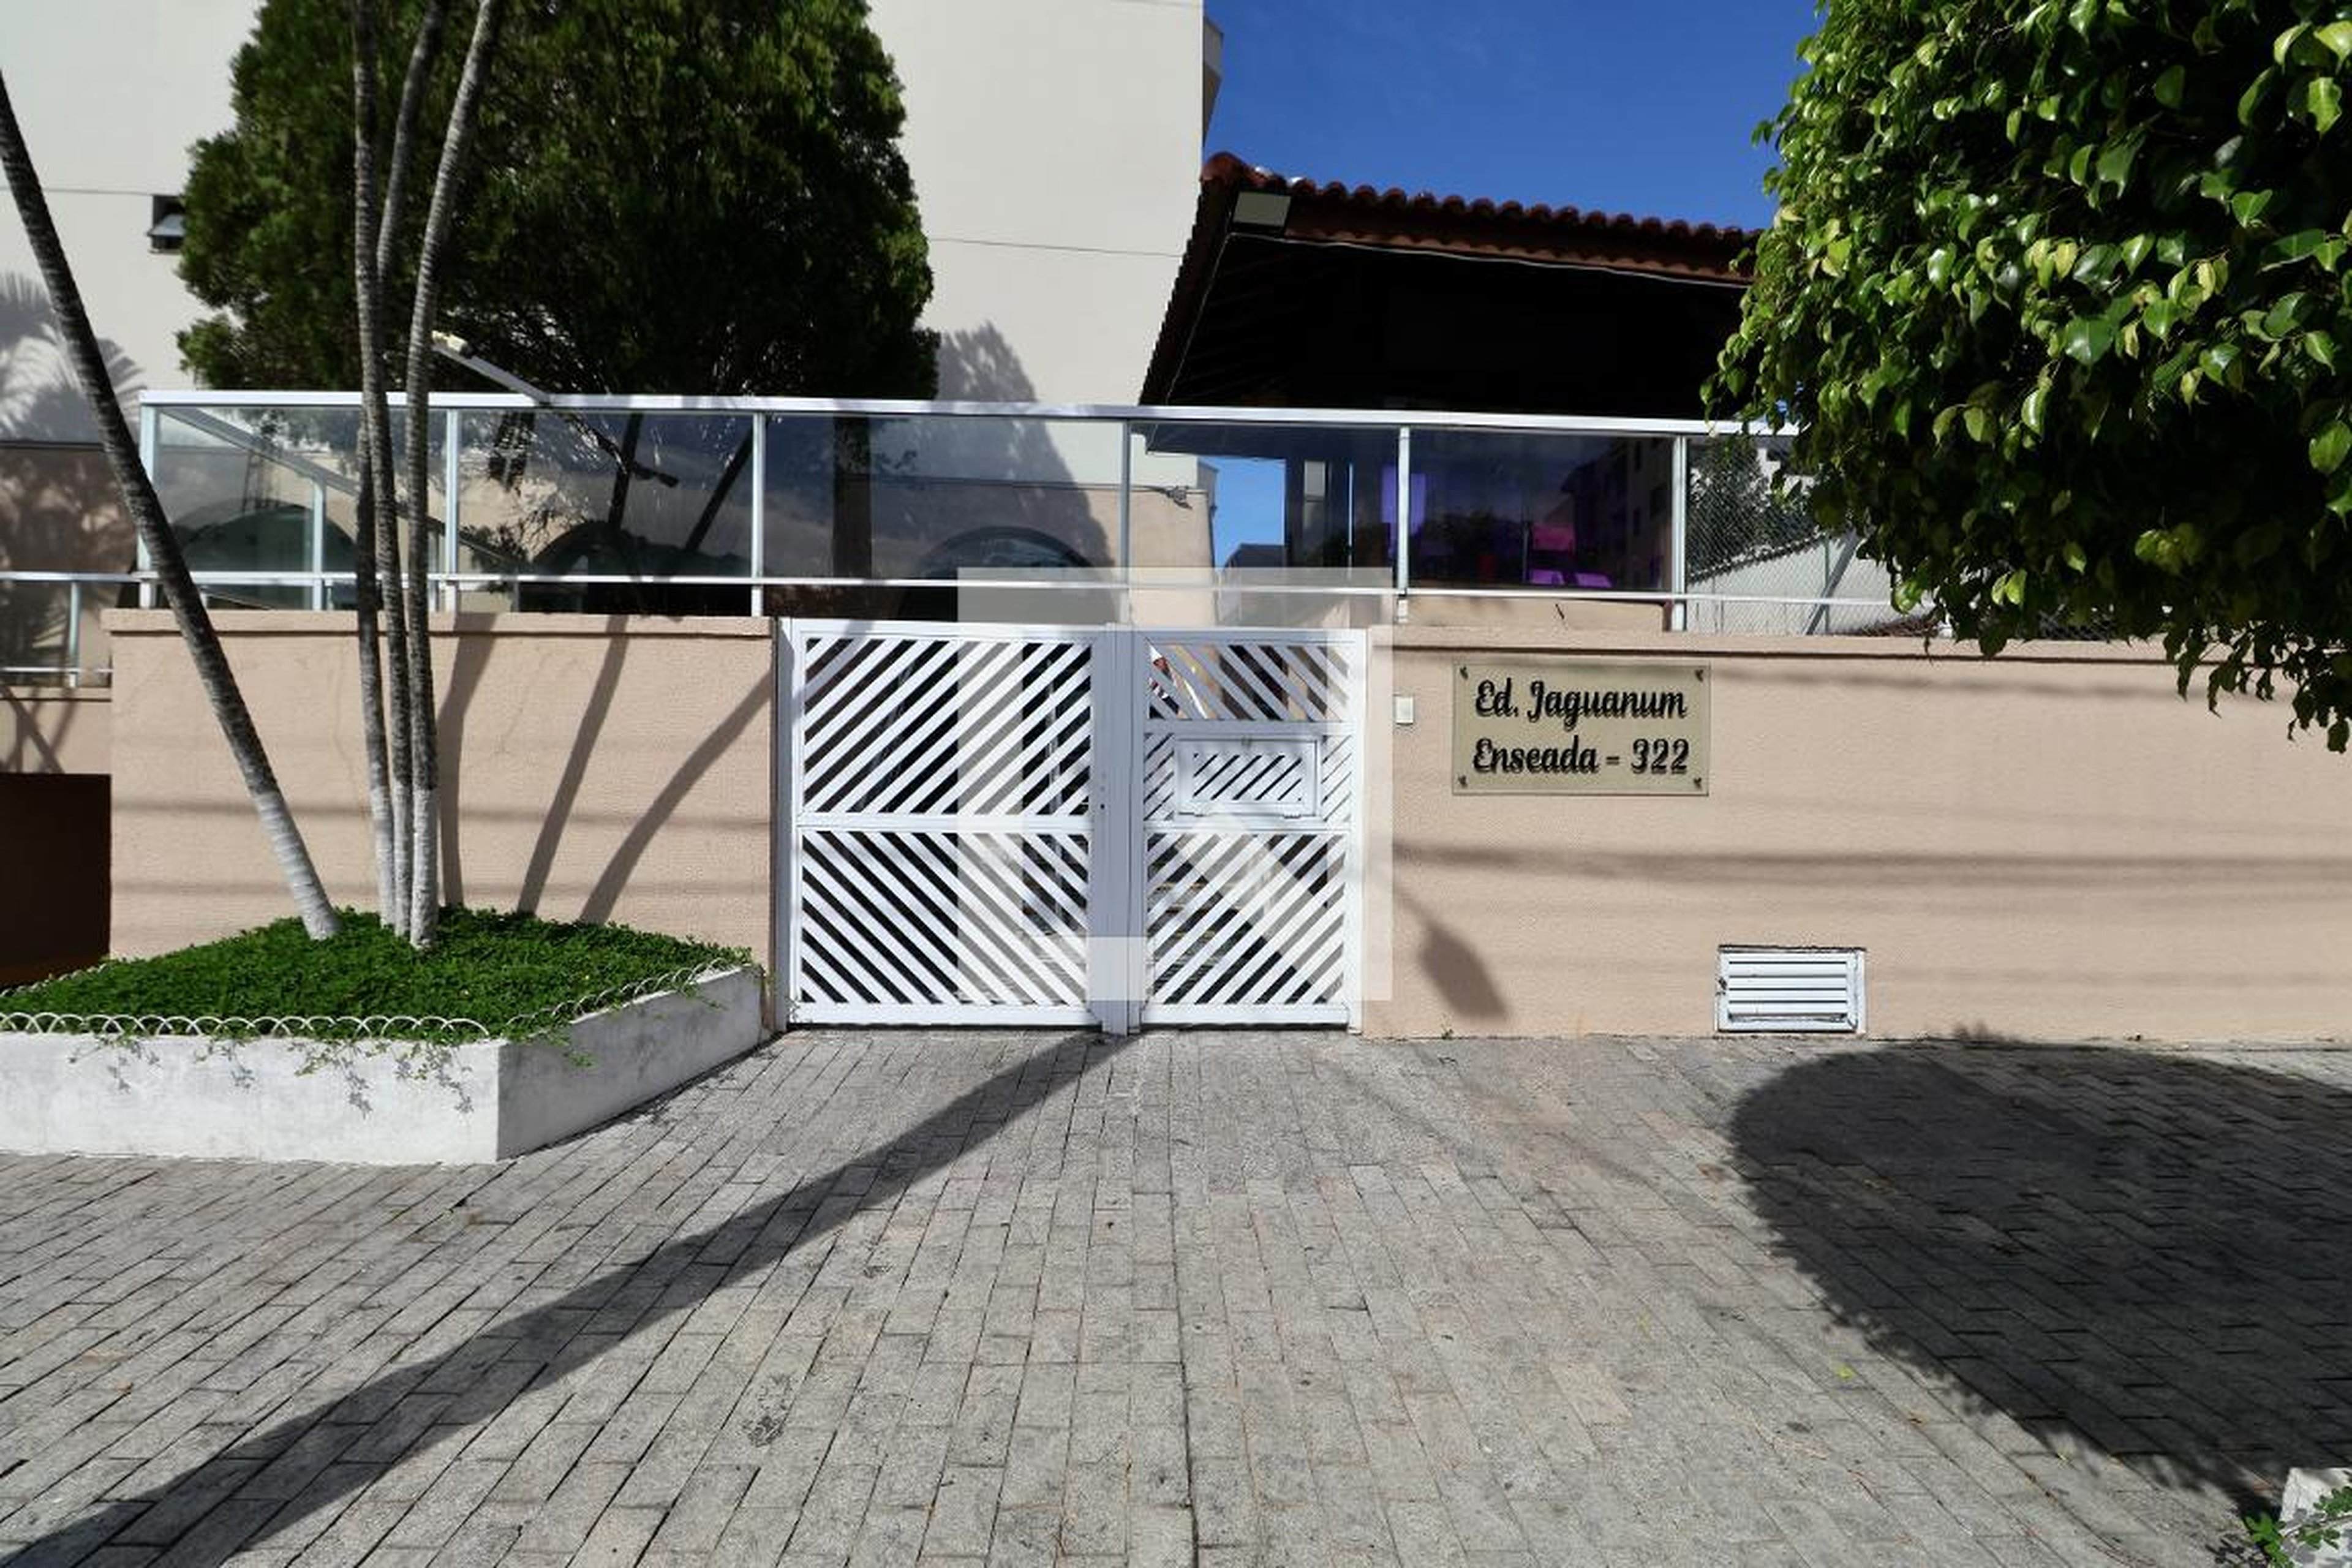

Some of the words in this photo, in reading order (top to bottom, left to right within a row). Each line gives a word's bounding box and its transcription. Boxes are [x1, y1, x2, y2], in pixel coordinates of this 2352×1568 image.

[1475, 677, 1519, 717] Ed.
[1527, 680, 1687, 731] Jaguanum
[1474, 735, 1599, 774] Enseada
[1631, 738, 1689, 774] 322
